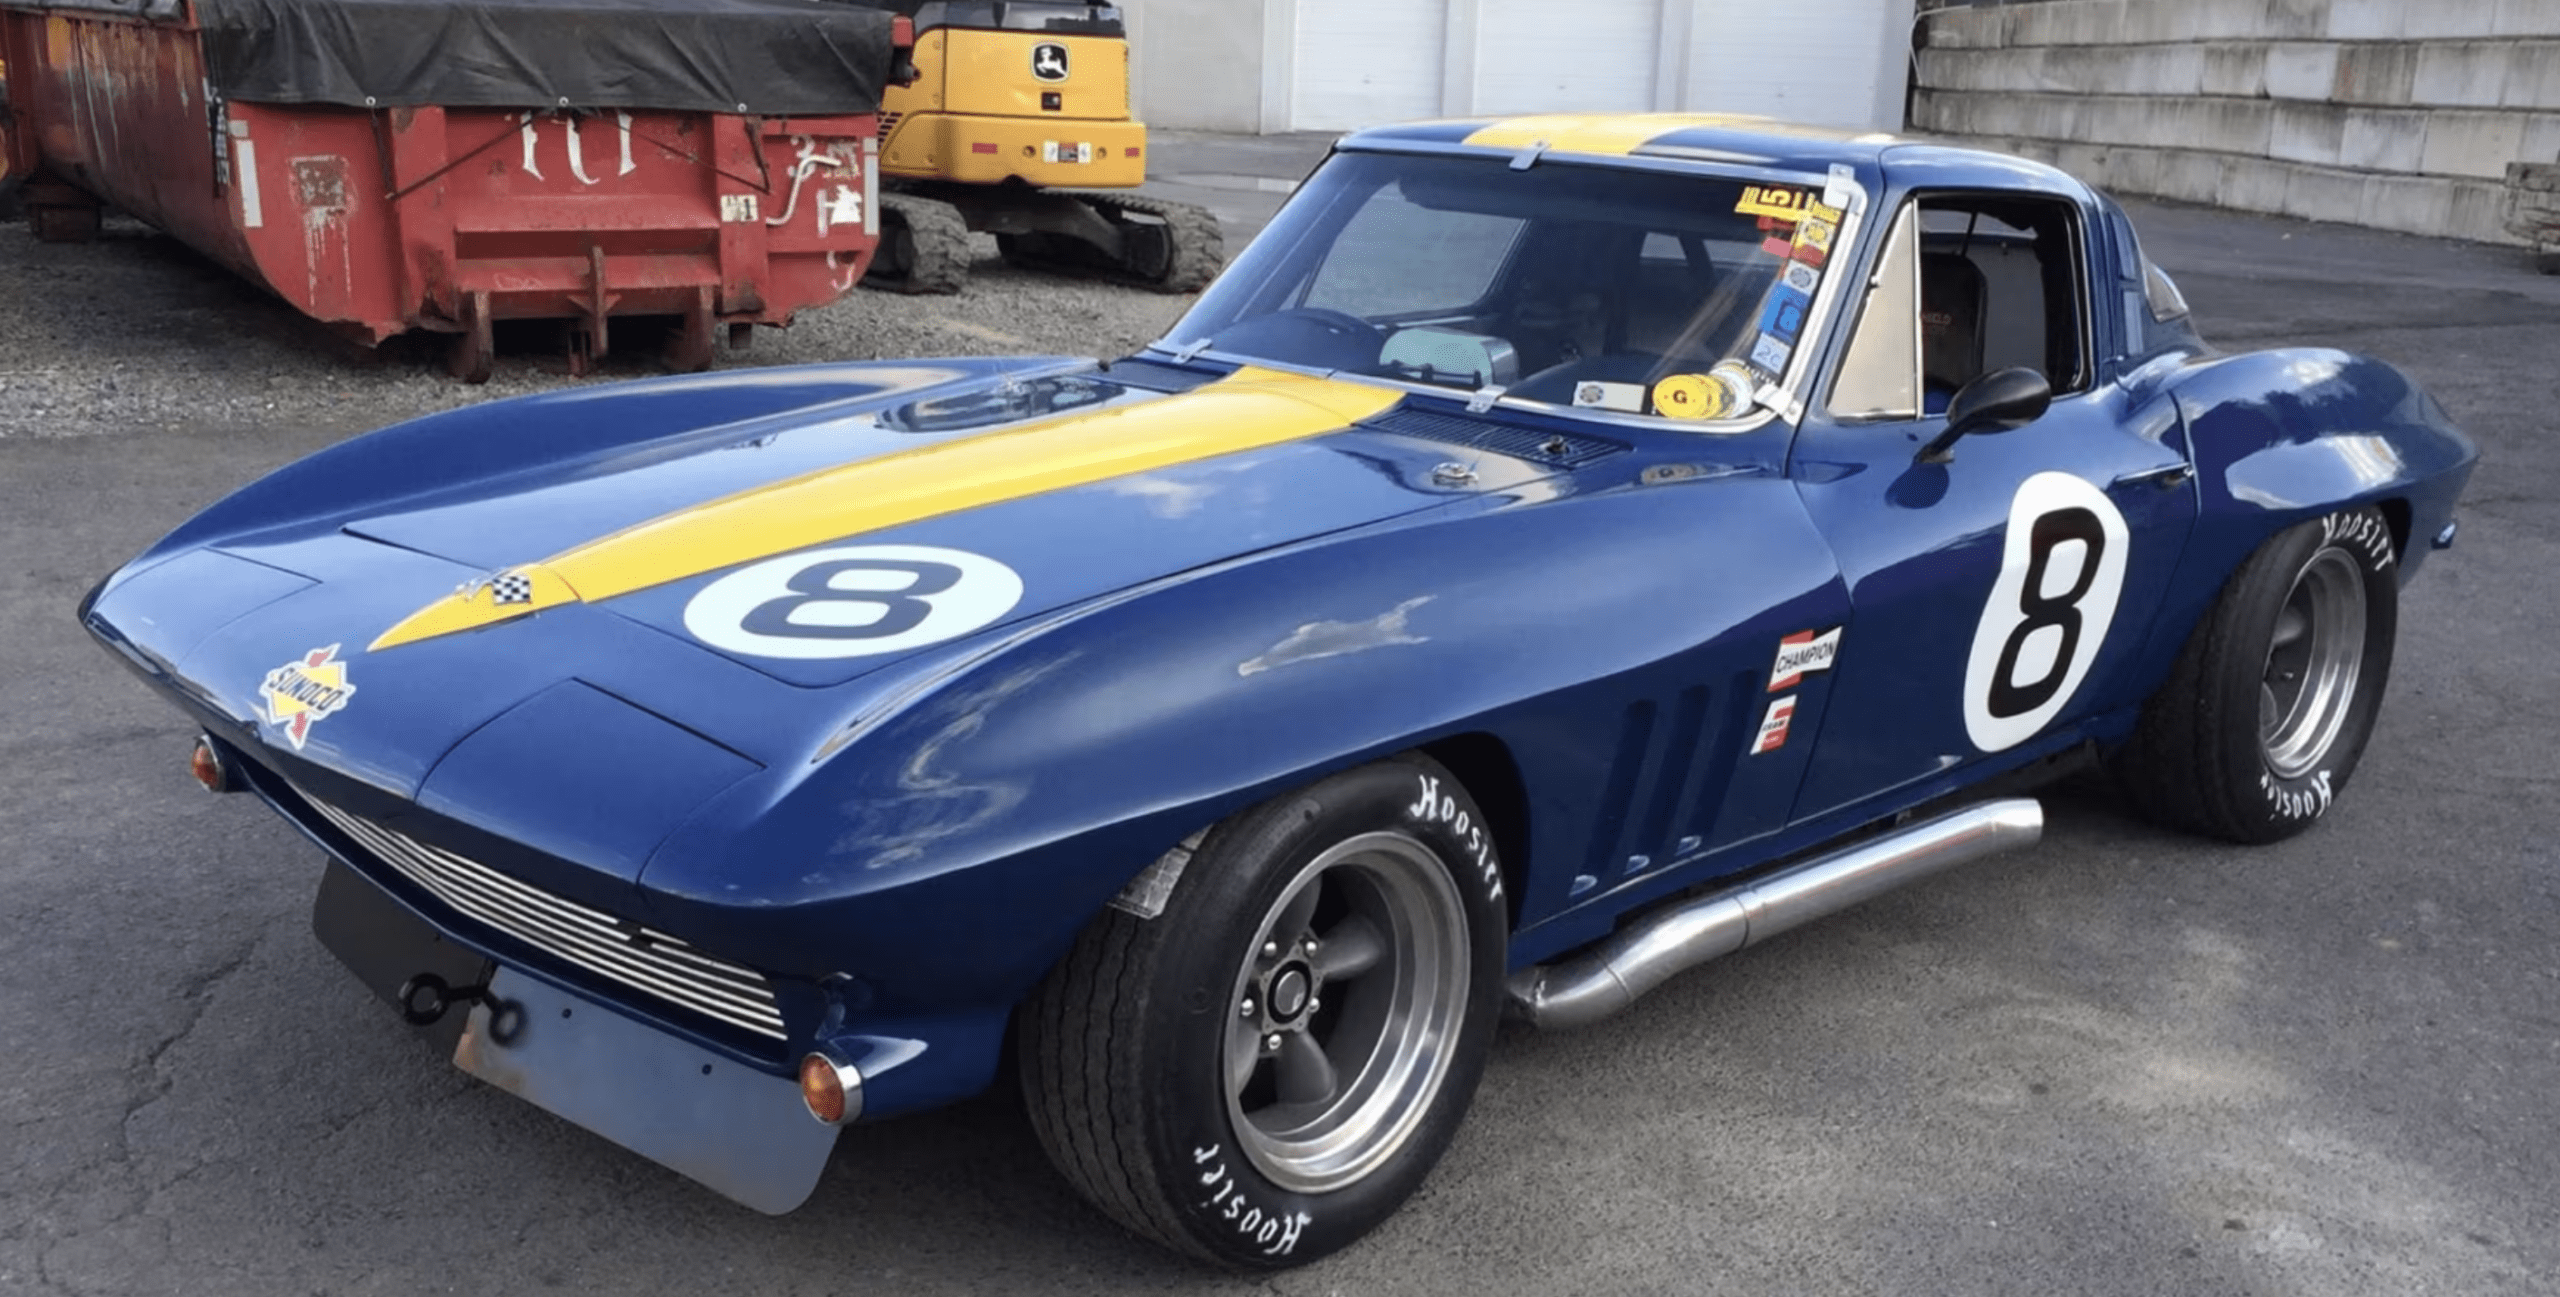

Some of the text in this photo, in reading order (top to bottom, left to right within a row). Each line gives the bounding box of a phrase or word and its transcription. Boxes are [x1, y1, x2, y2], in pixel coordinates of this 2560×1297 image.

[1672, 389, 1688, 405] G
[740, 559, 963, 640] 8
[1987, 506, 2106, 719] 8
[1776, 642, 1834, 674] CHAMPION
[268, 667, 345, 711] SUNOCO
